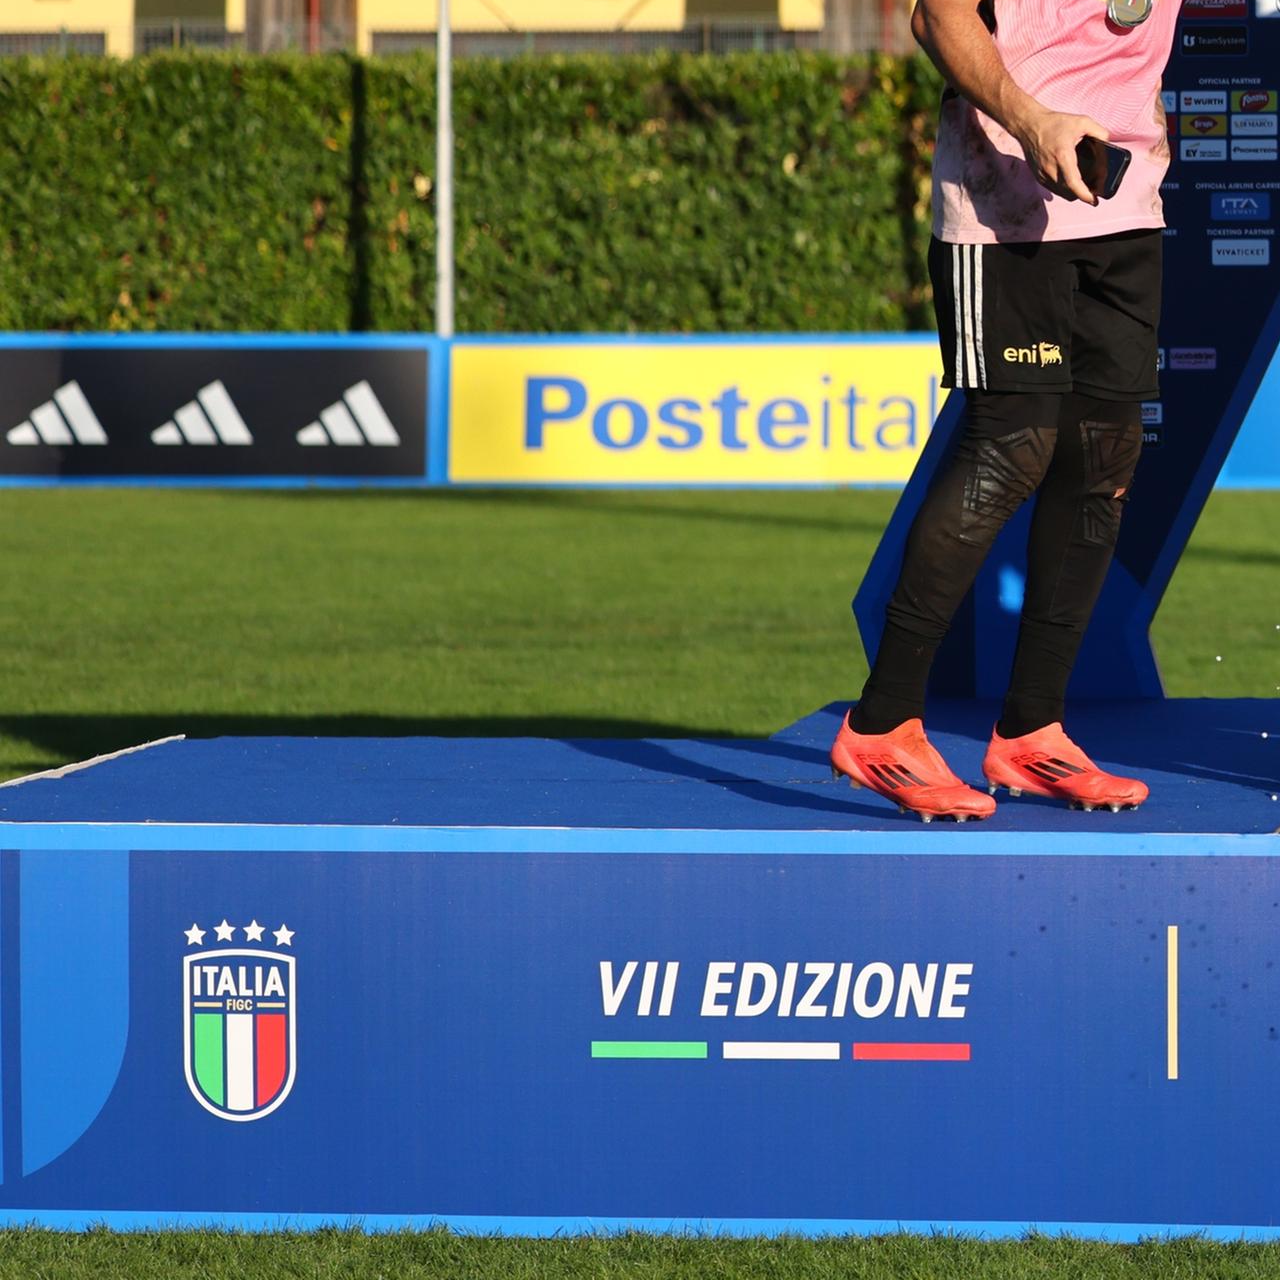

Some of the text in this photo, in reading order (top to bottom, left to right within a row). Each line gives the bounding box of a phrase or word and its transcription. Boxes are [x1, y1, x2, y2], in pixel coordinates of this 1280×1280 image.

[1198, 35, 1246, 47] TeamSystem
[1199, 77, 1261, 85] OFFICIAL PARTNER
[1185, 149, 1198, 157] EY
[1195, 182, 1226, 190] OFFICIAL
[1228, 182, 1254, 190] AIRLINE
[1221, 198, 1258, 209] ITA
[1216, 248, 1265, 257] VIVATICKET
[1003, 344, 1037, 364] eni
[193, 965, 286, 997] ITALIA
[600, 961, 974, 1018] VII EDIZIONE
[226, 998, 253, 1012] FIGC
